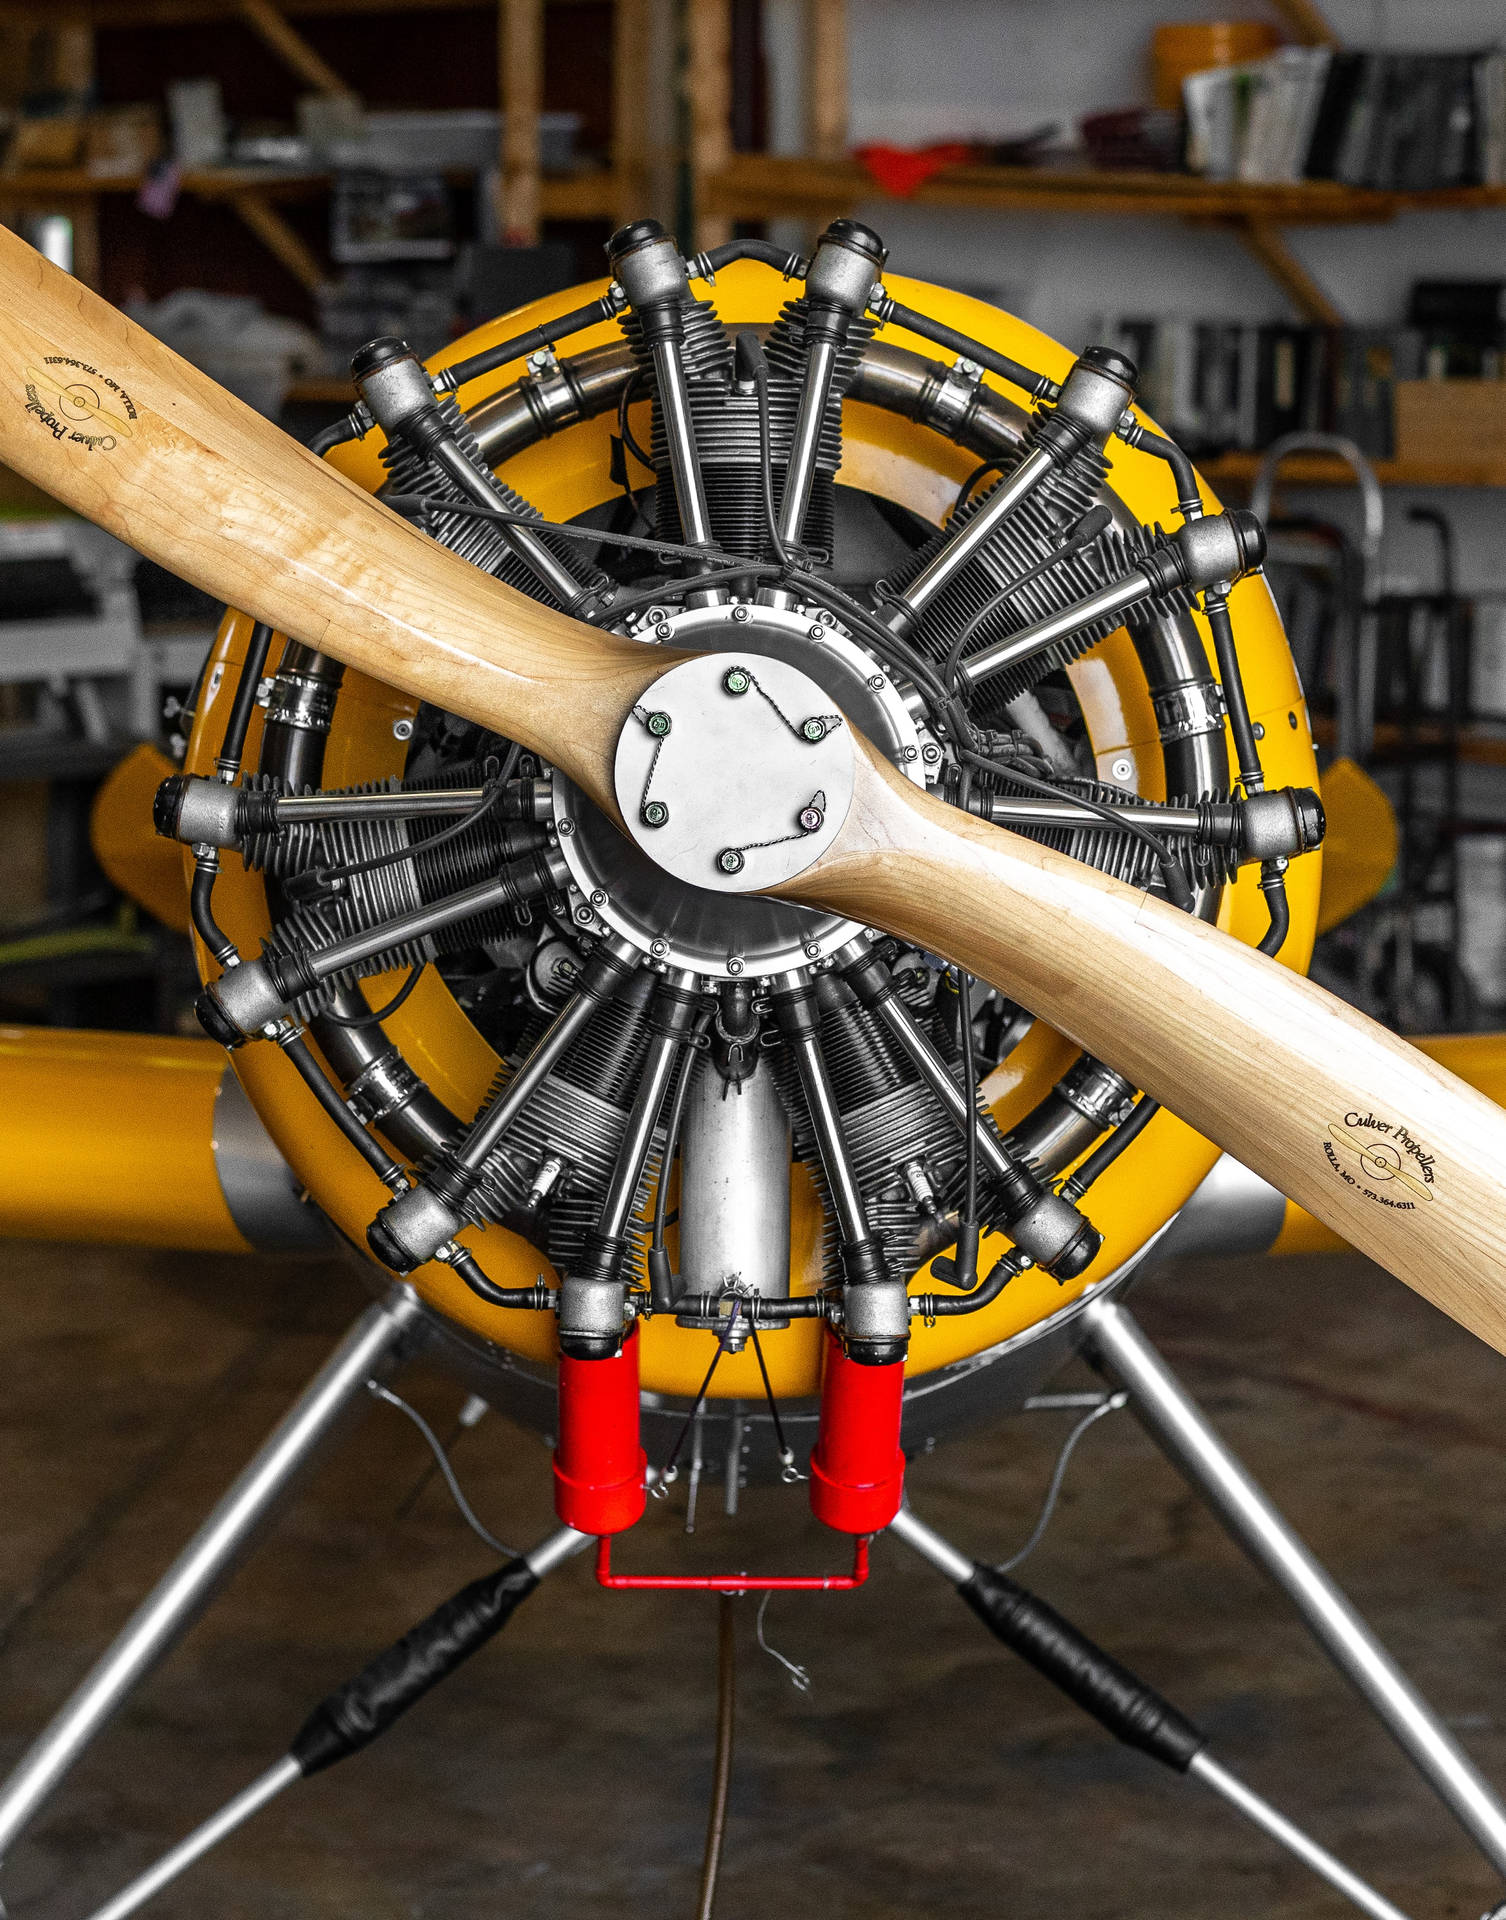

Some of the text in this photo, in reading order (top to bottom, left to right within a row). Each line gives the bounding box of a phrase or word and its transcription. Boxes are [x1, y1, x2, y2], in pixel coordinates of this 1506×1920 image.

[43, 356, 98, 375] 573.364.6311
[104, 378, 121, 392] MO
[25, 383, 117, 452] Culver Propellers
[1323, 1141, 1416, 1210] ROLLA, MO 573.364.6311
[1343, 1112, 1436, 1184] Culver Propellers
